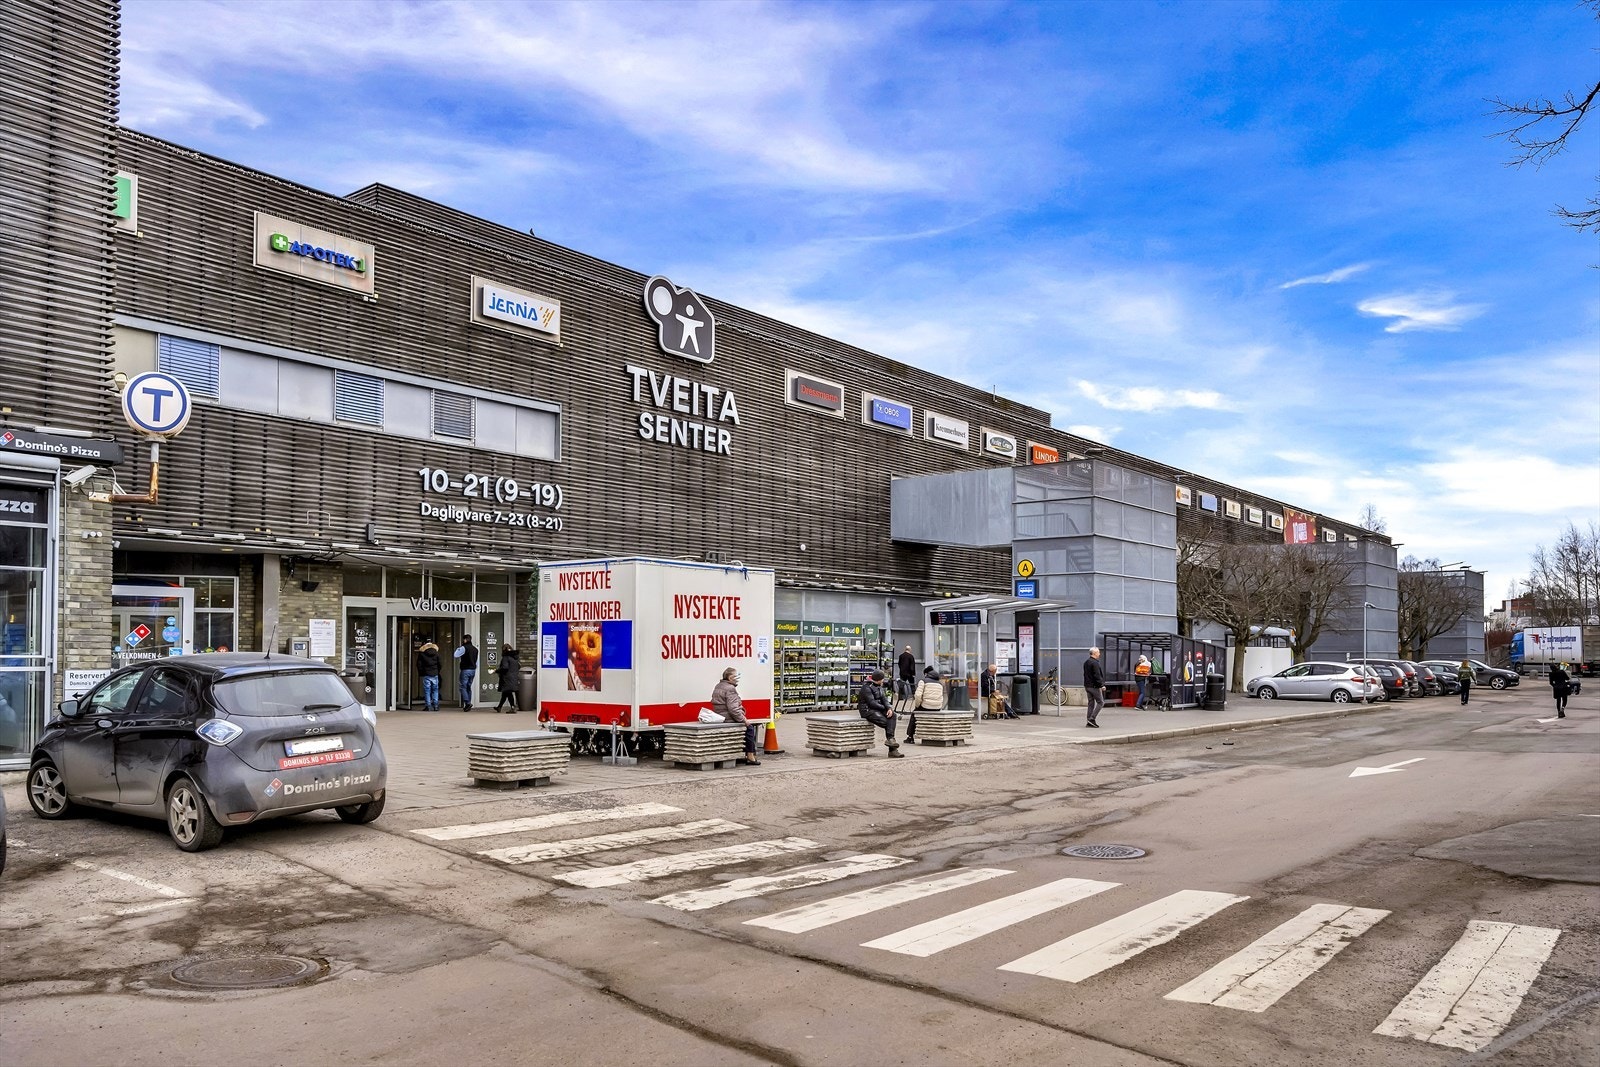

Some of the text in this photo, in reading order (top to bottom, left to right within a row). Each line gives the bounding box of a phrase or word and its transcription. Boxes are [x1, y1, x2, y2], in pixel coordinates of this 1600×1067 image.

[290, 240, 366, 272] APOTEK 1
[626, 364, 741, 425] TVEITA
[800, 383, 839, 403] Dressmann
[142, 387, 174, 422] T
[884, 406, 900, 418] OBOS
[639, 411, 731, 455] SENTER
[15, 438, 101, 458] Domino's Pizza
[1034, 450, 1058, 463] LINDEX
[421, 502, 492, 523] Dagligvare
[1022, 563, 1029, 572] A
[558, 570, 612, 592] NYSTEKTE
[410, 597, 490, 614] Velkommen
[549, 600, 622, 621] SMULTRINGER
[674, 594, 741, 620] NYSTEKTE
[661, 634, 753, 659] SMULTRINGER
[304, 726, 326, 735] ZOE
[283, 757, 319, 767] DOMINOS.NO
[284, 775, 371, 795] Domino's Pizza
